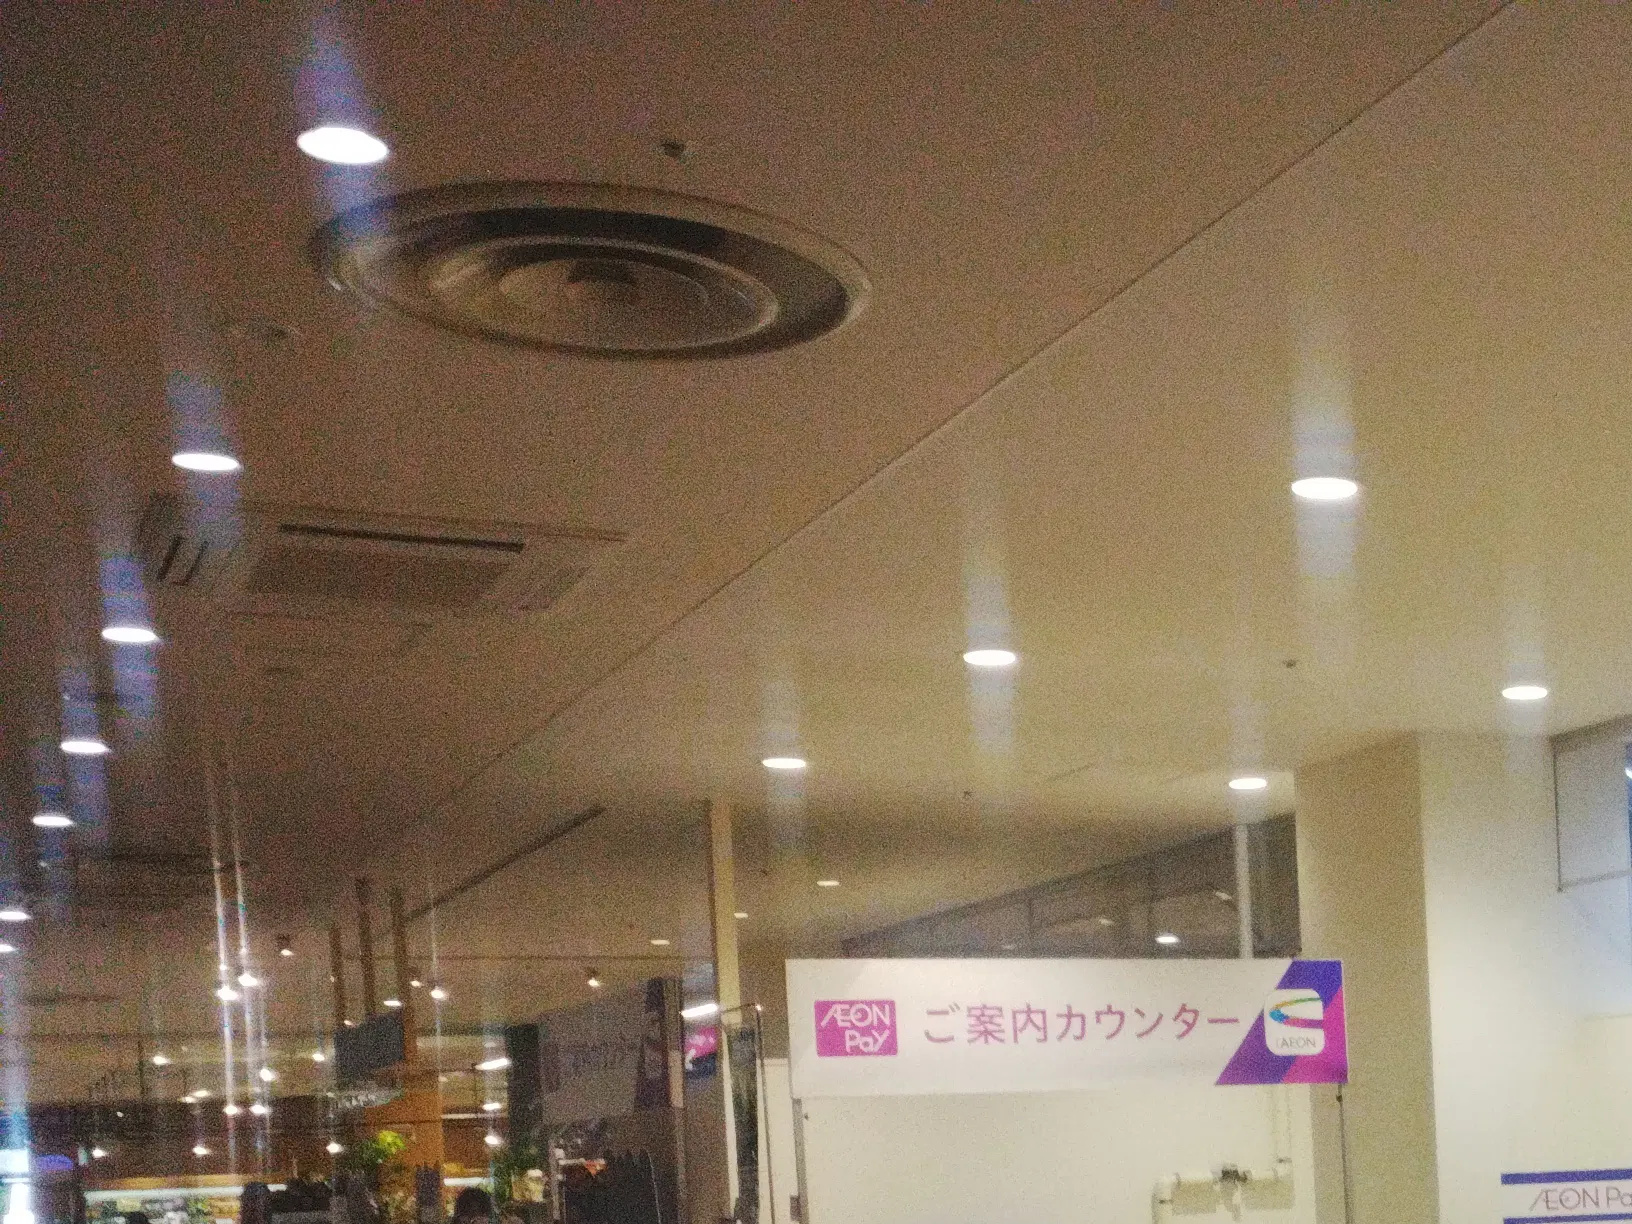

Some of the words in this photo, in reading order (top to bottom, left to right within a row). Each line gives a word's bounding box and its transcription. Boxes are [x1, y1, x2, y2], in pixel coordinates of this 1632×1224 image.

[923, 1002, 1241, 1046] ご案内カウンター
